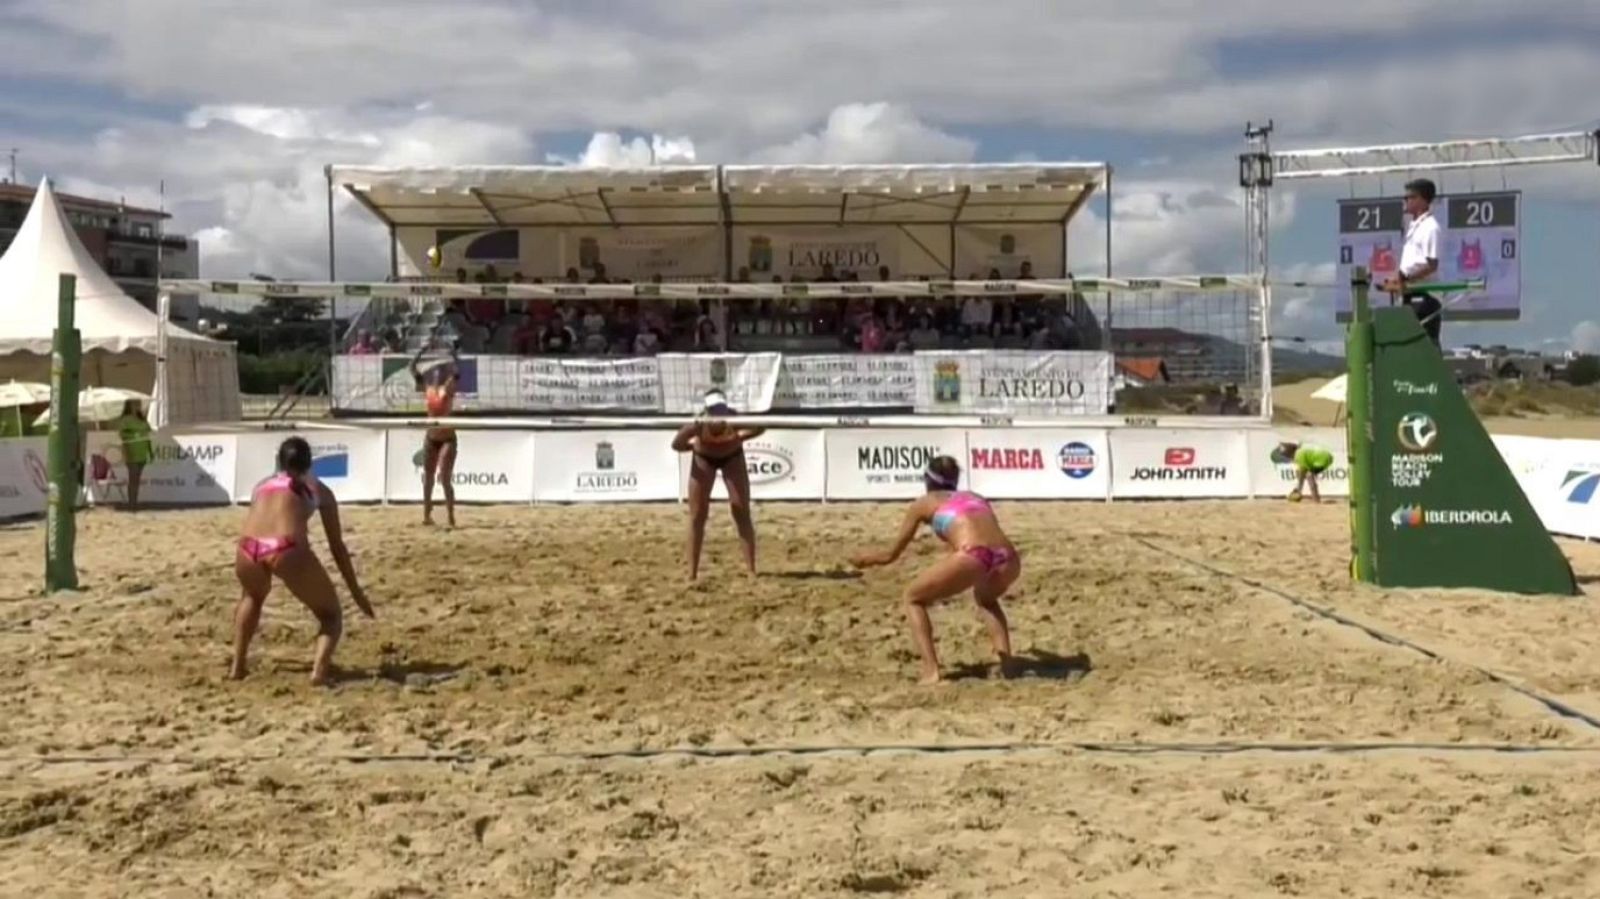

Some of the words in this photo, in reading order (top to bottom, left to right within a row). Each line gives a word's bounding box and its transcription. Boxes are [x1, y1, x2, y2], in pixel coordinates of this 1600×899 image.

[1357, 207, 1381, 230] 21
[1466, 201, 1494, 226] 20
[789, 249, 880, 267] LAREDO
[979, 378, 1085, 399] LAREDO
[858, 446, 935, 470] MADISON
[971, 448, 1044, 469] MARCA
[1392, 454, 1443, 463] MADISON
[1130, 467, 1174, 480] JOHN
[1176, 467, 1226, 480] SMITH
[1392, 463, 1428, 471] BEACH
[577, 476, 638, 488] LAREDO
[1392, 470, 1432, 480] VOLLEY
[1392, 479, 1421, 487] TOUR
[1425, 510, 1512, 524] IBERDROLA
